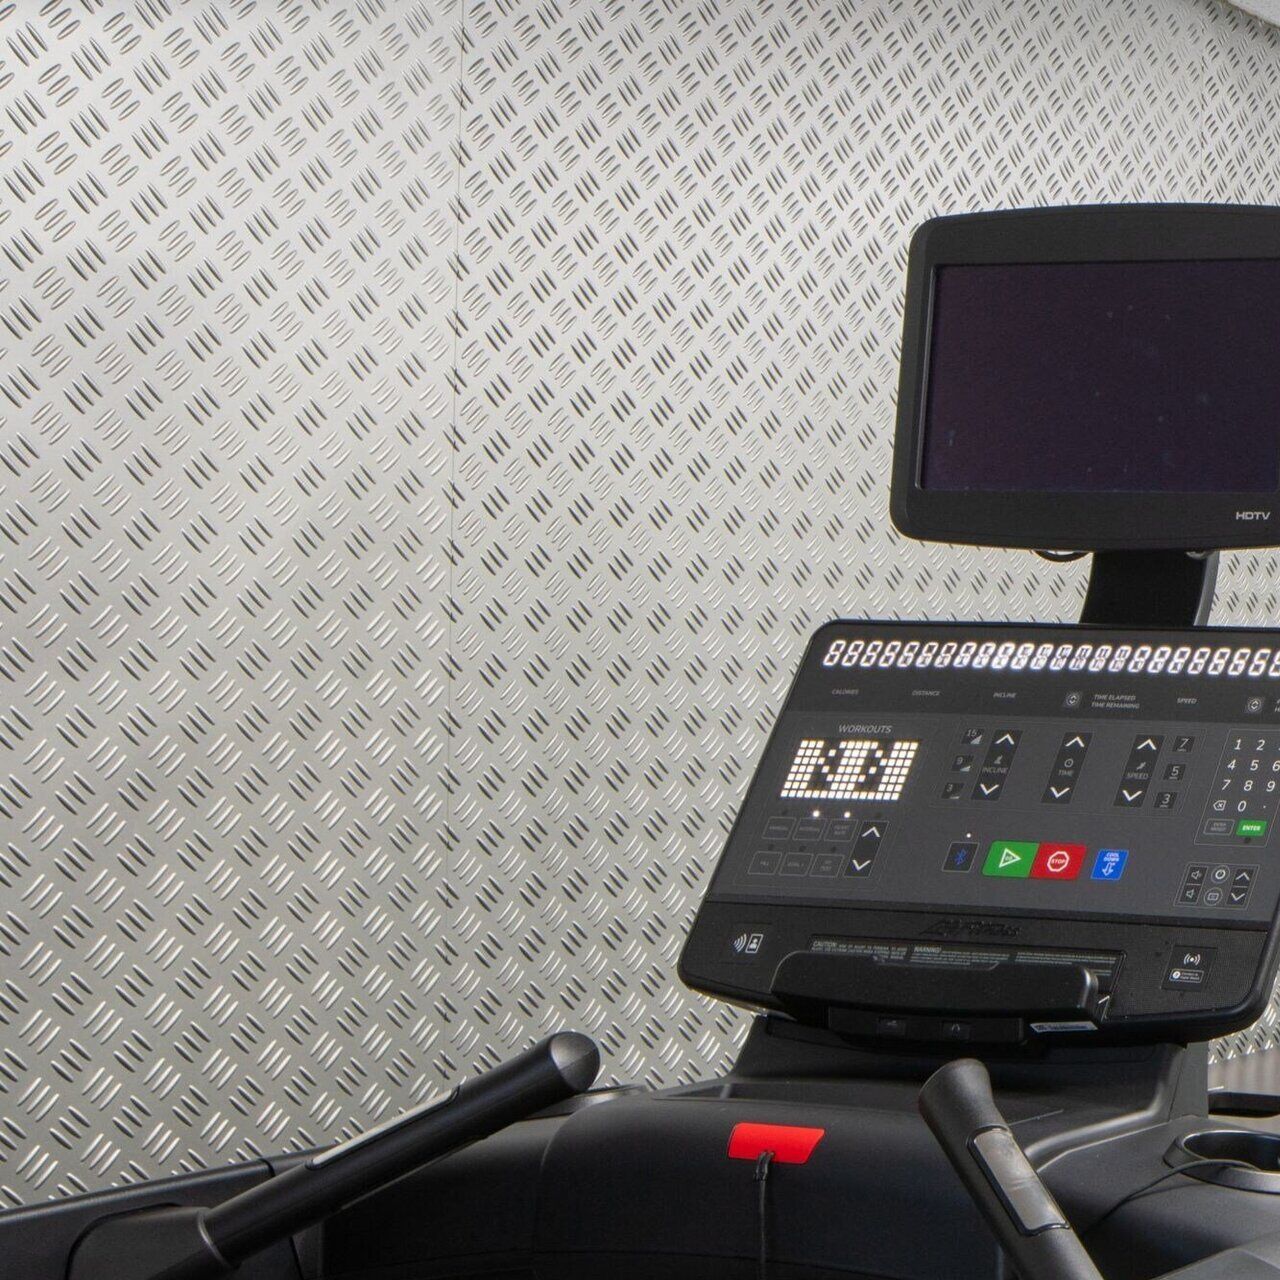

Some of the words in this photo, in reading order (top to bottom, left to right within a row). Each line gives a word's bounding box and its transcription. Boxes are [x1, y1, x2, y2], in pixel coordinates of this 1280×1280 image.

[1235, 511, 1271, 520] HDTV
[1108, 694, 1136, 702] ELAPSED
[1091, 701, 1105, 709] TIME
[838, 723, 893, 735] WORKOUTS
[966, 729, 978, 737] 15
[1179, 738, 1190, 749] 7
[1234, 739, 1242, 750] 1
[1256, 739, 1265, 751] 2
[956, 756, 964, 765] 9
[1227, 760, 1237, 771] 4
[1250, 760, 1259, 772] 5
[1272, 761, 1280, 772] 6
[1058, 769, 1074, 777] TIME
[1126, 772, 1149, 780] SPEED
[1170, 766, 1179, 777] 5
[946, 784, 954, 793] 3
[1222, 780, 1232, 791] 7
[1243, 780, 1253, 792] 8
[1265, 781, 1276, 792] 9
[1160, 794, 1170, 805] 3
[1237, 801, 1247, 812] 0
[1240, 824, 1261, 832] ENTER
